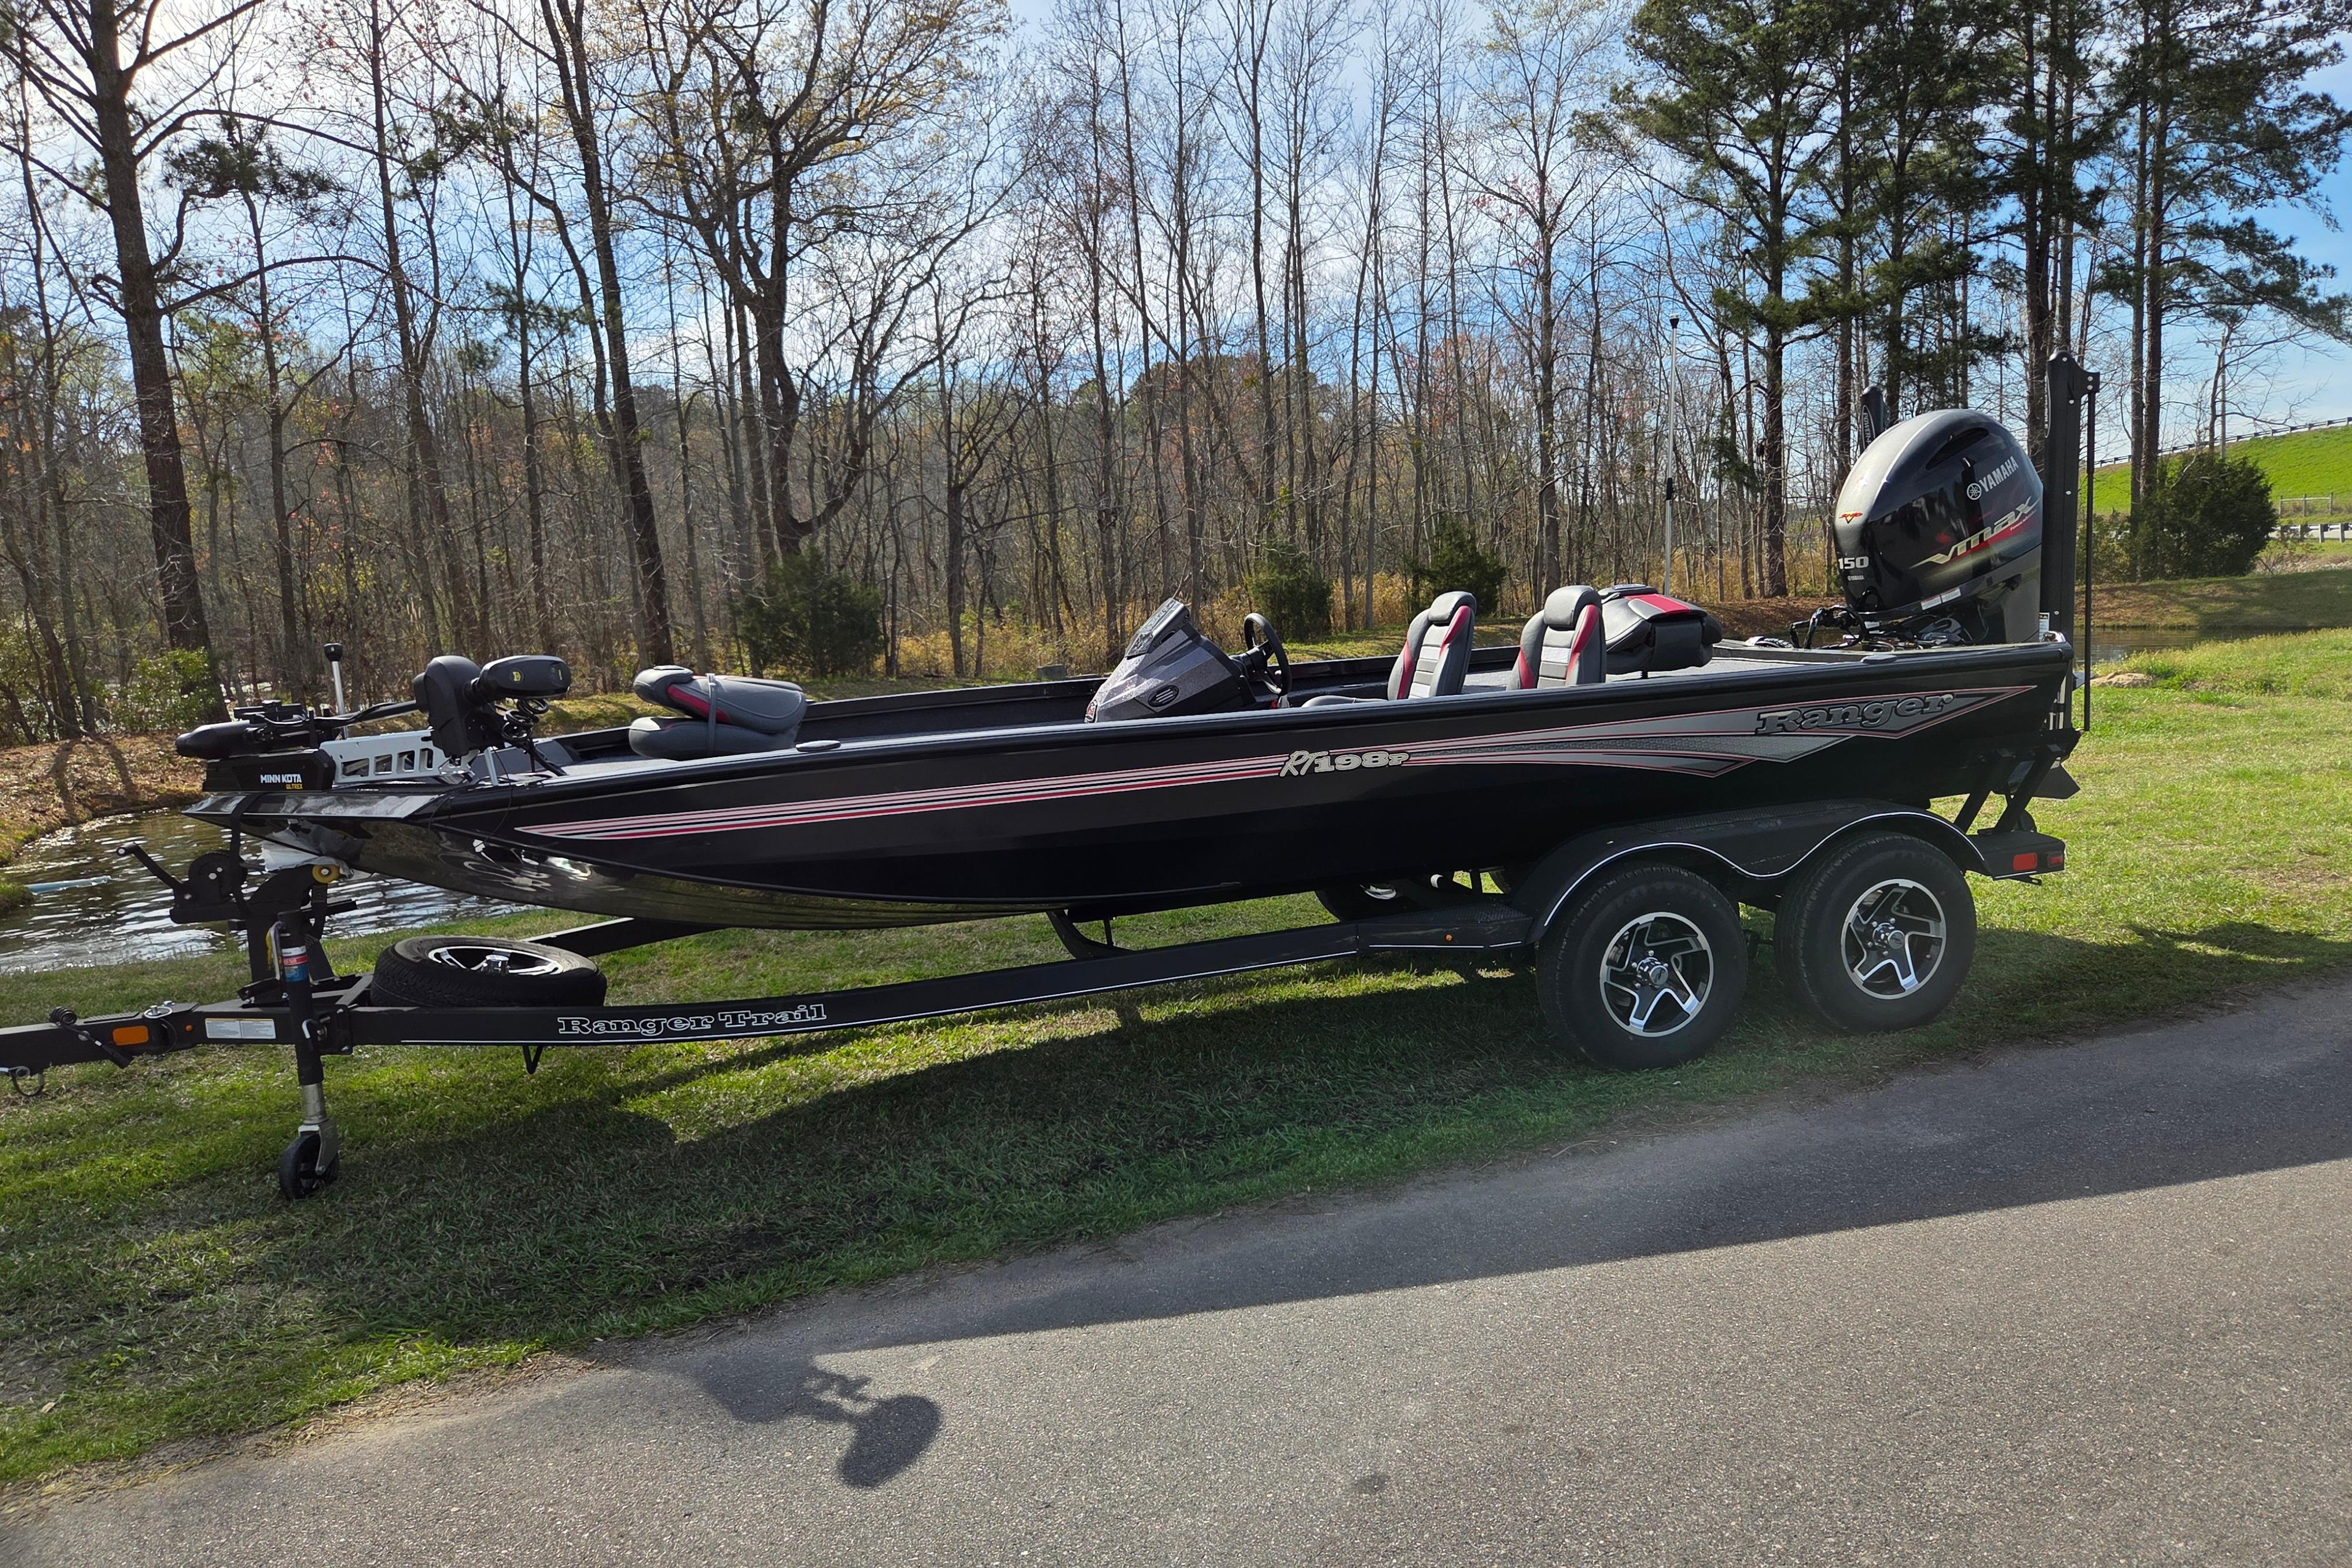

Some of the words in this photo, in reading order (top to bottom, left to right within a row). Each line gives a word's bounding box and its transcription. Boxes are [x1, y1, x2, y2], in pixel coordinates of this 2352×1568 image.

[1979, 456, 2019, 492] YAMAHA
[1838, 556, 1869, 570] 150
[1756, 693, 1955, 734] Ranger
[260, 774, 281, 783] MINN
[282, 774, 302, 783] KOTA
[557, 1015, 714, 1036] Ranger
[719, 1004, 827, 1028] Trail
